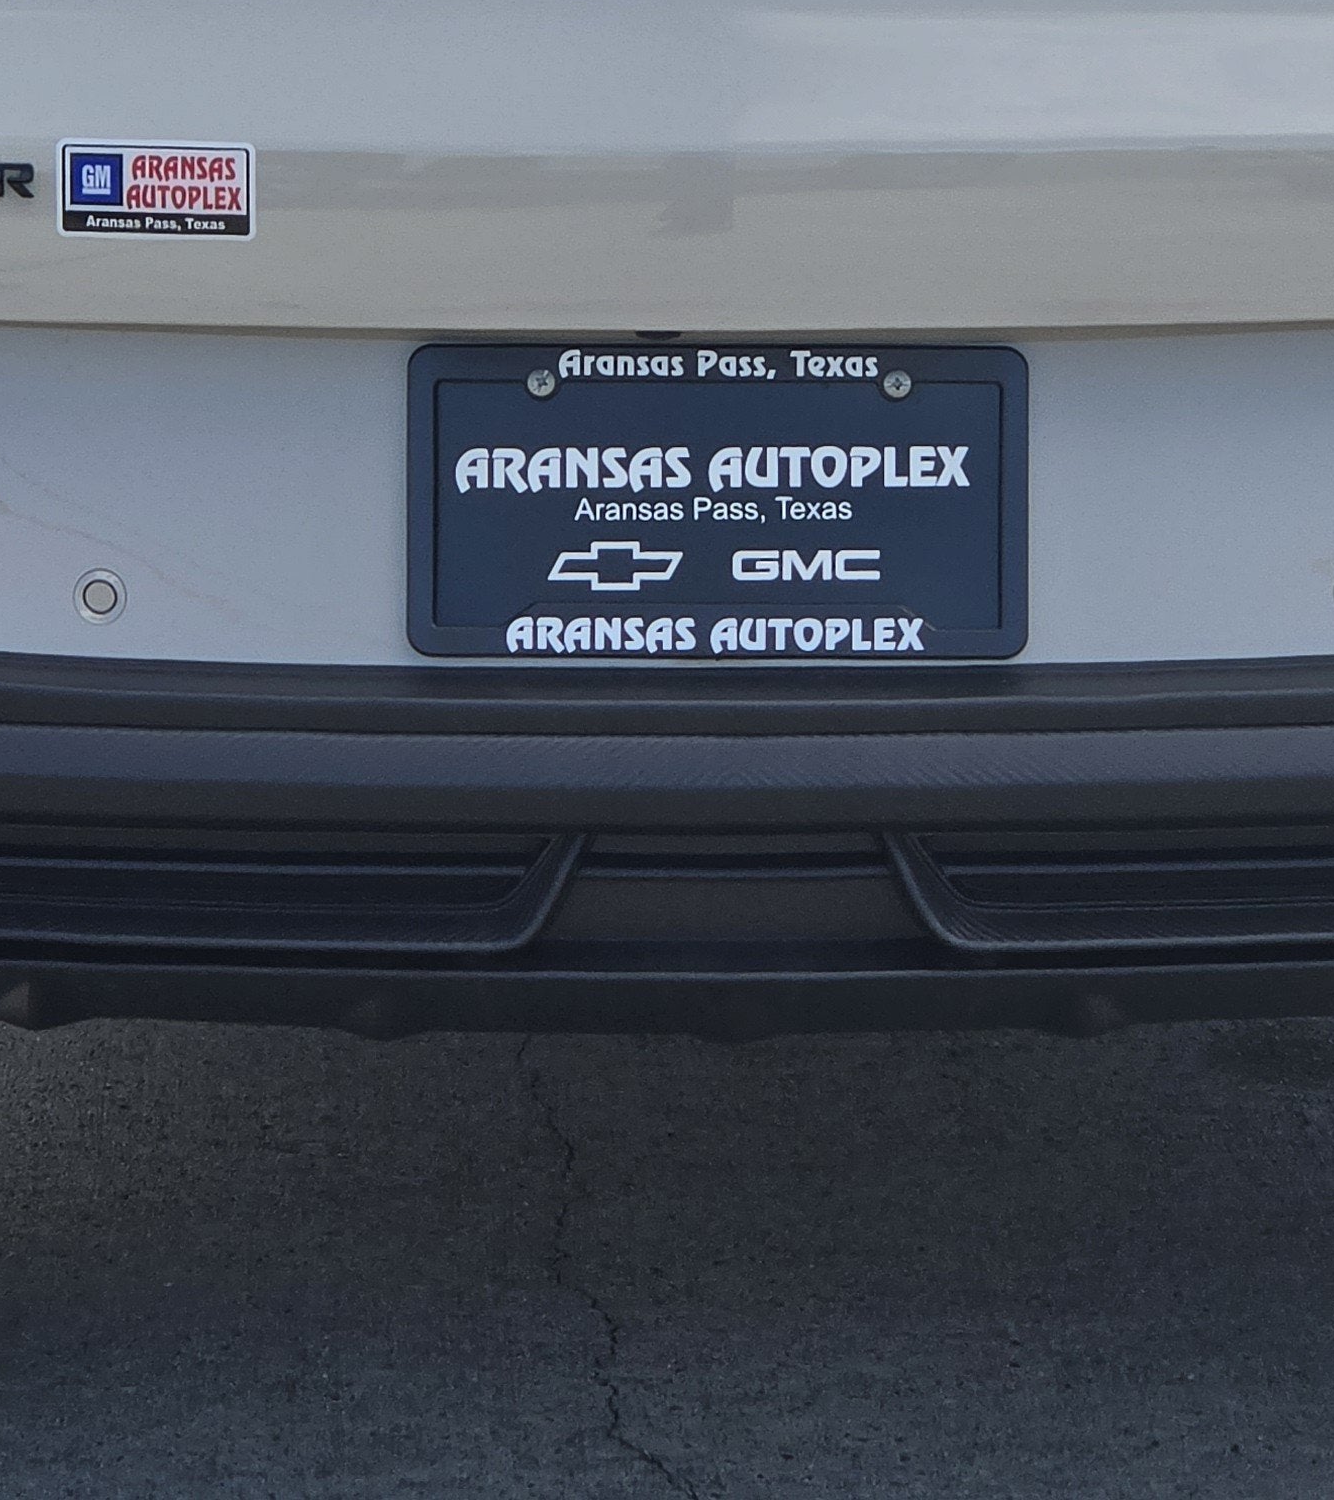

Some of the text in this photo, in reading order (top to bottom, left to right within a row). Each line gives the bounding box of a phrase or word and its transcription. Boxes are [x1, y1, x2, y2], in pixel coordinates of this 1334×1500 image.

[82, 164, 111, 189] GM
[131, 154, 236, 183] ARANSAS
[126, 184, 242, 211] AUTOPLEX
[86, 215, 226, 231] Aransas Pass, Texas
[558, 349, 879, 380] Aransas Pass, Texas
[455, 446, 970, 494] ARANSAS AUTOPLEX
[574, 496, 853, 523] Aransas Pass, Texas
[732, 549, 881, 580] GMC
[506, 616, 925, 654] ARANSAS AUTOPLEX
